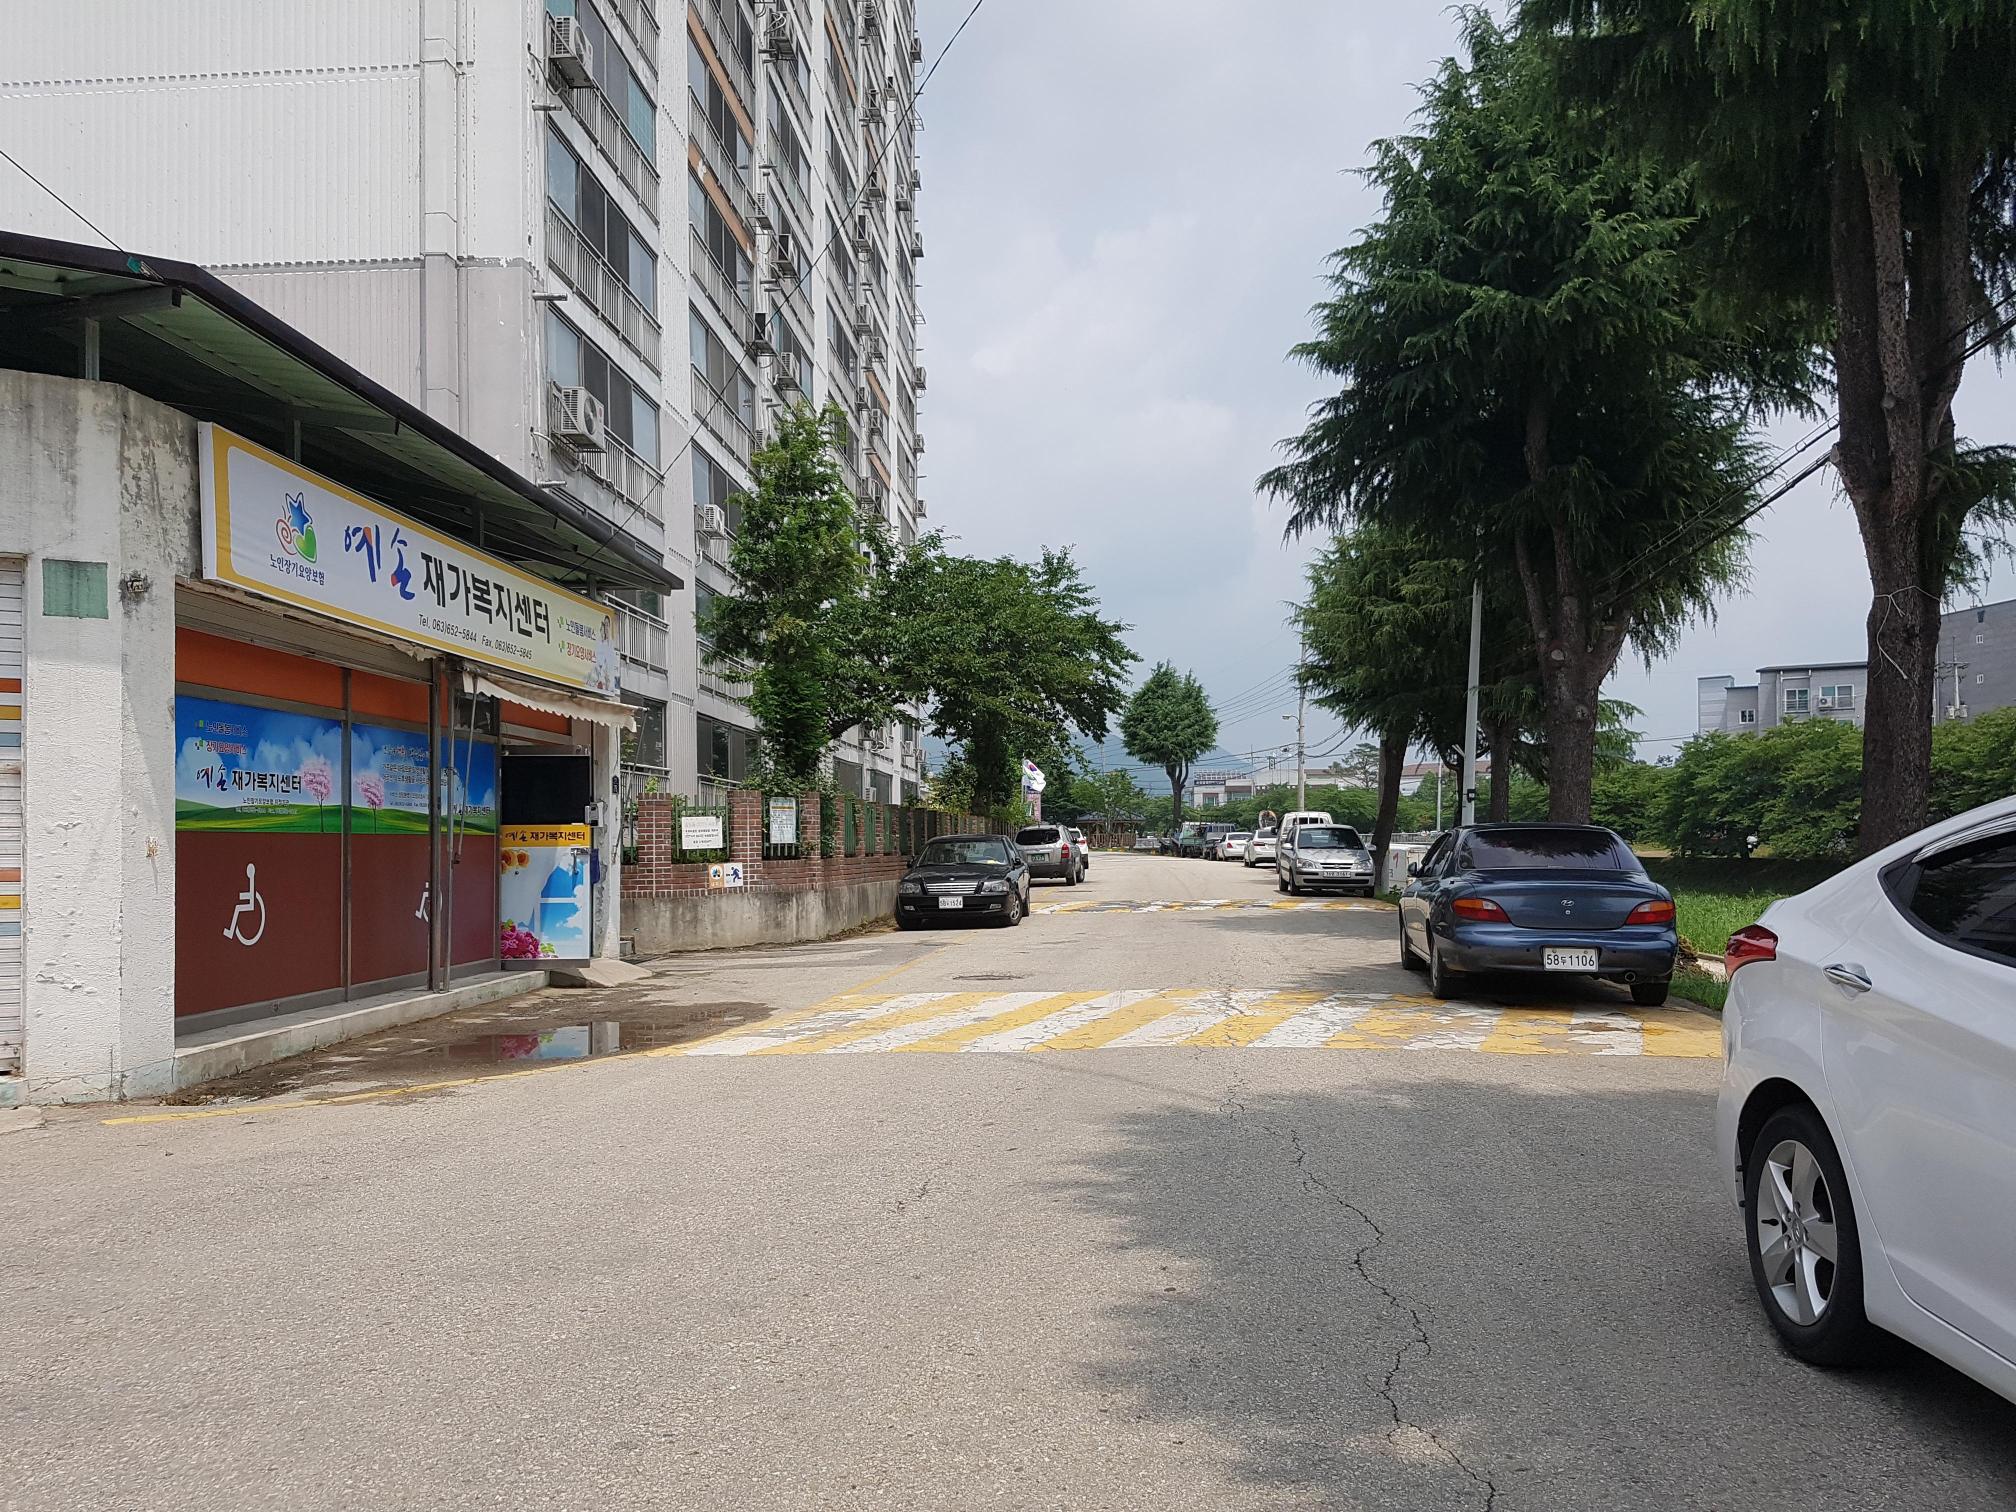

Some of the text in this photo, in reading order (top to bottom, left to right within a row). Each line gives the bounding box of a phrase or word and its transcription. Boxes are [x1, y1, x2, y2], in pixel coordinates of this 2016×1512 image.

[270, 554, 325, 585] 노인장기요양보험
[421, 551, 550, 644] 재가복지센터
[419, 614, 430, 628] Tel.
[432, 618, 477, 642] 063)652-5844
[481, 635, 493, 648] Fax.
[231, 771, 302, 794] 재가복지센터
[530, 831, 585, 841] 재가복지센터
